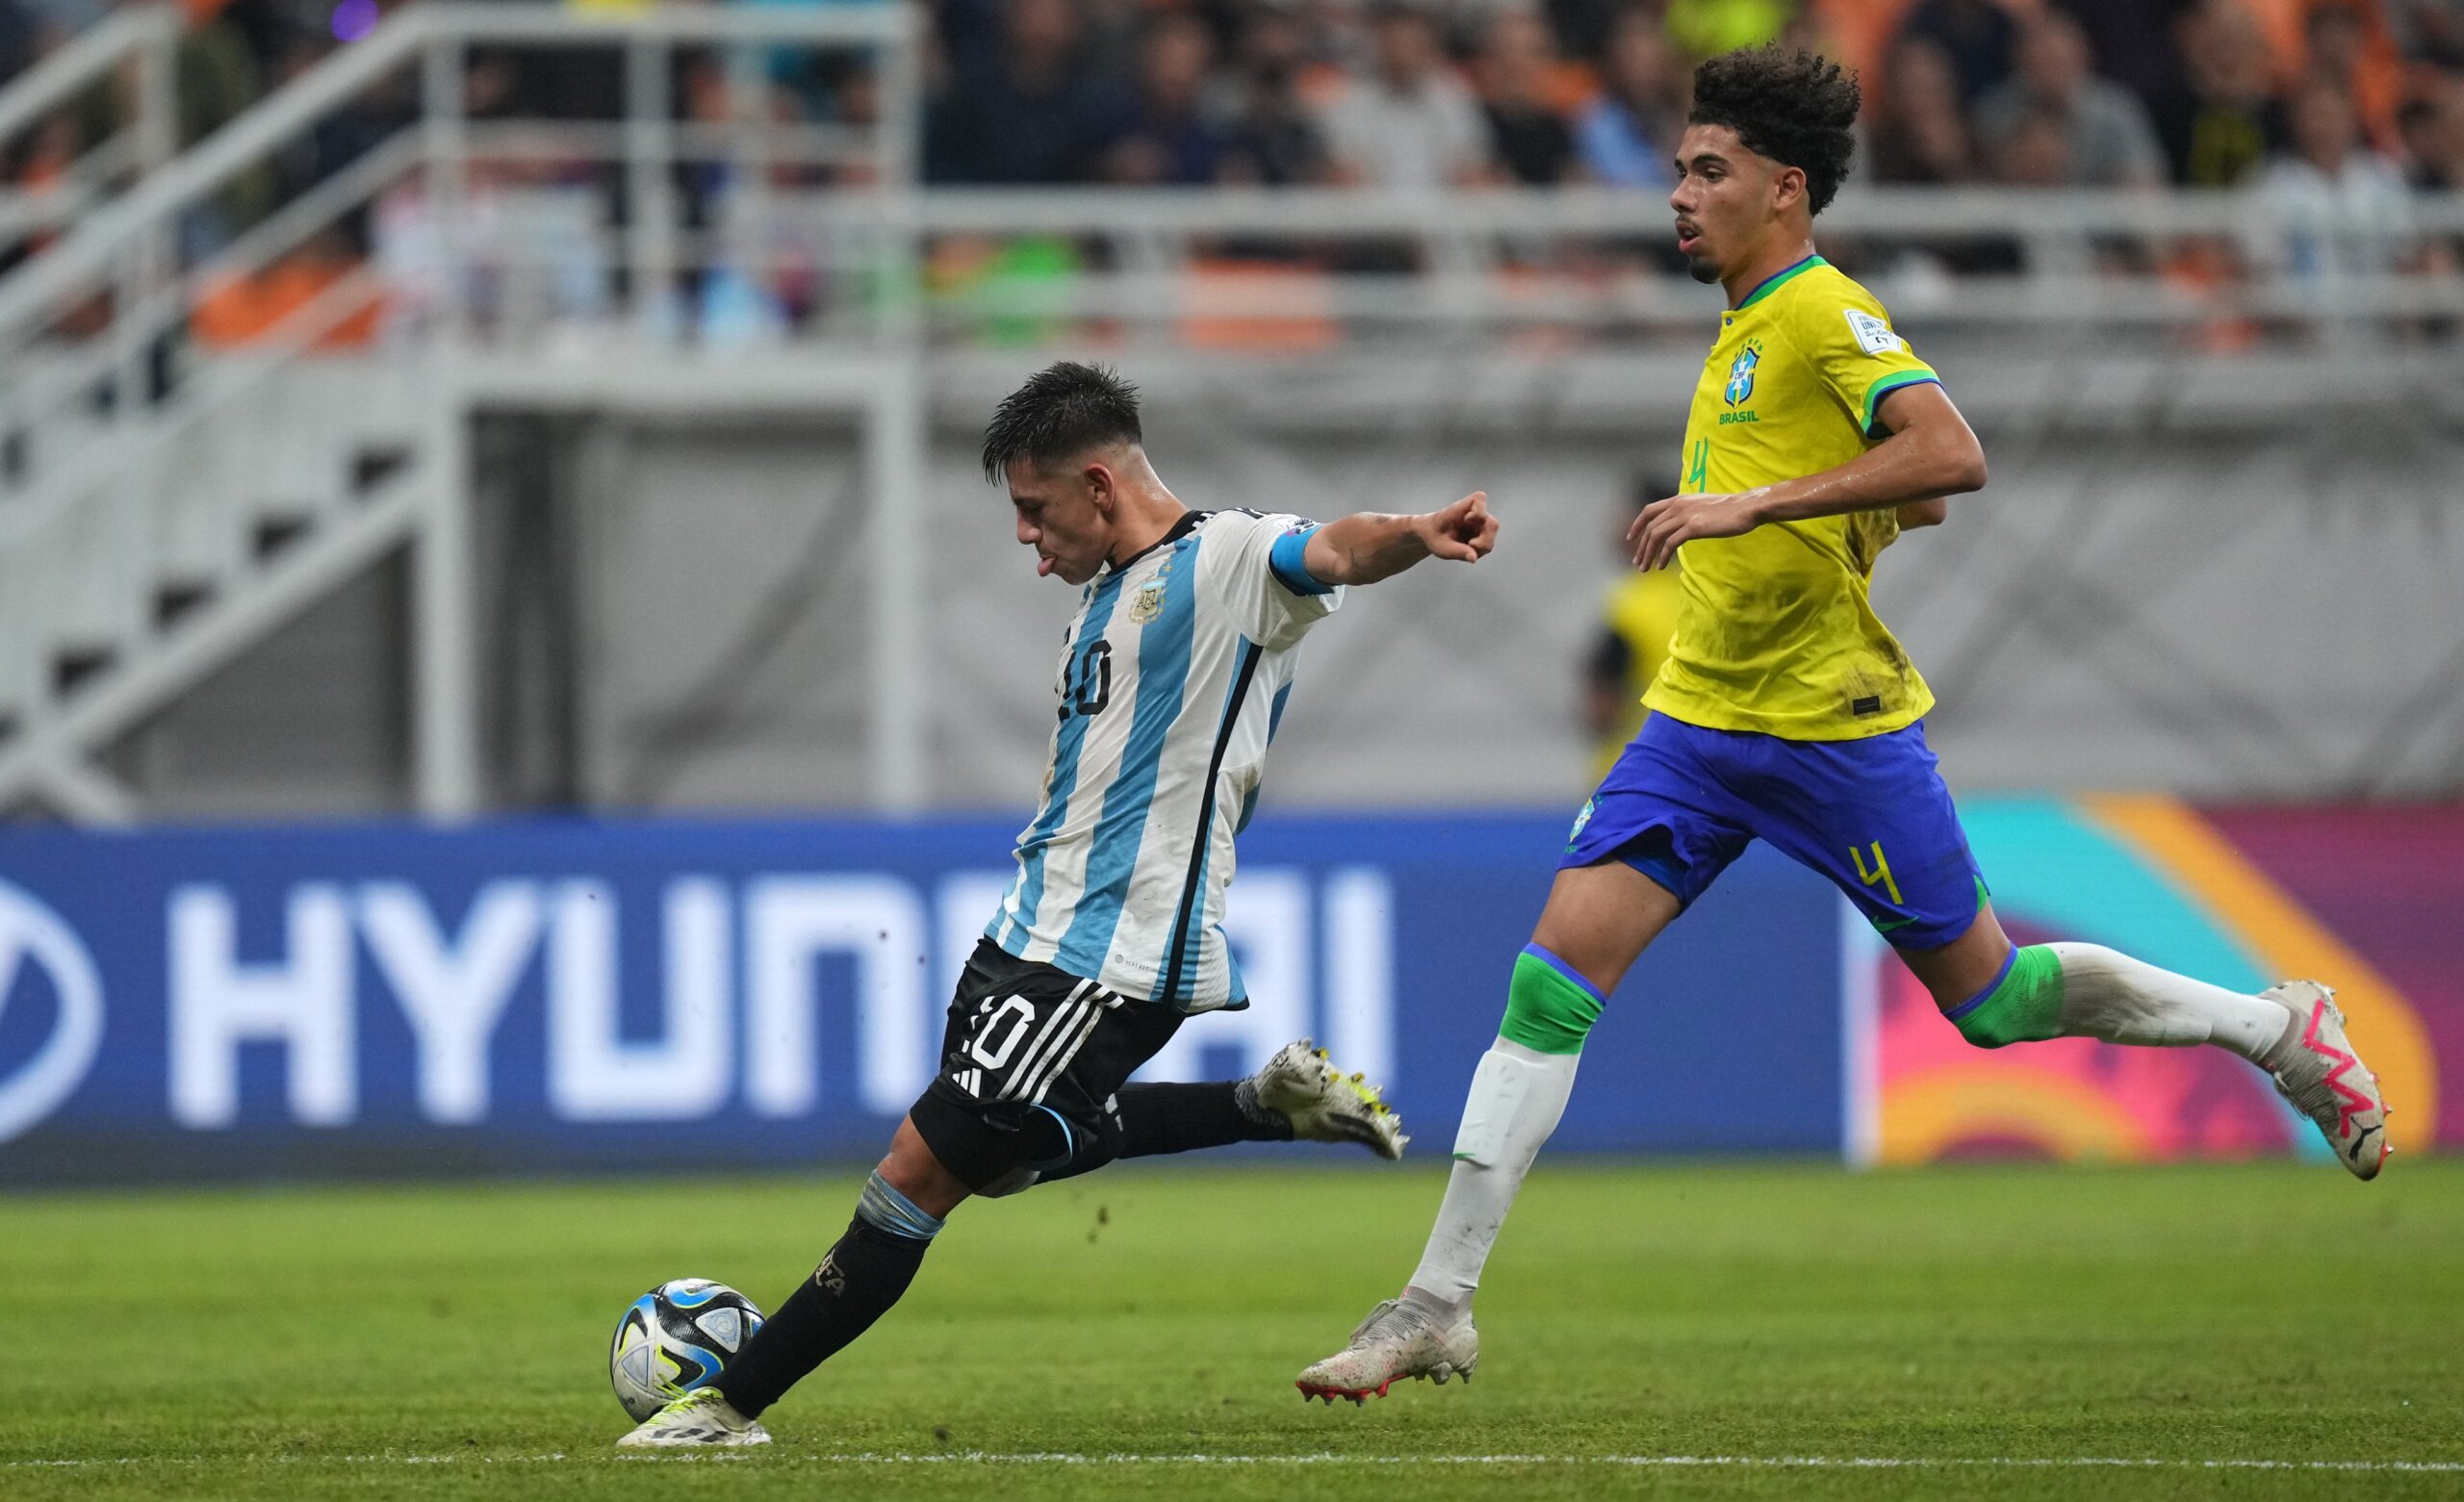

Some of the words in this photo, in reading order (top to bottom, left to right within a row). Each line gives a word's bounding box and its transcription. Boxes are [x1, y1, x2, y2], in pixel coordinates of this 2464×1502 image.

[1718, 410, 1759, 425] BRASIL
[1688, 435, 1708, 494] 4
[1848, 839, 1905, 905] 4
[167, 870, 1397, 1130] HYUNAI
